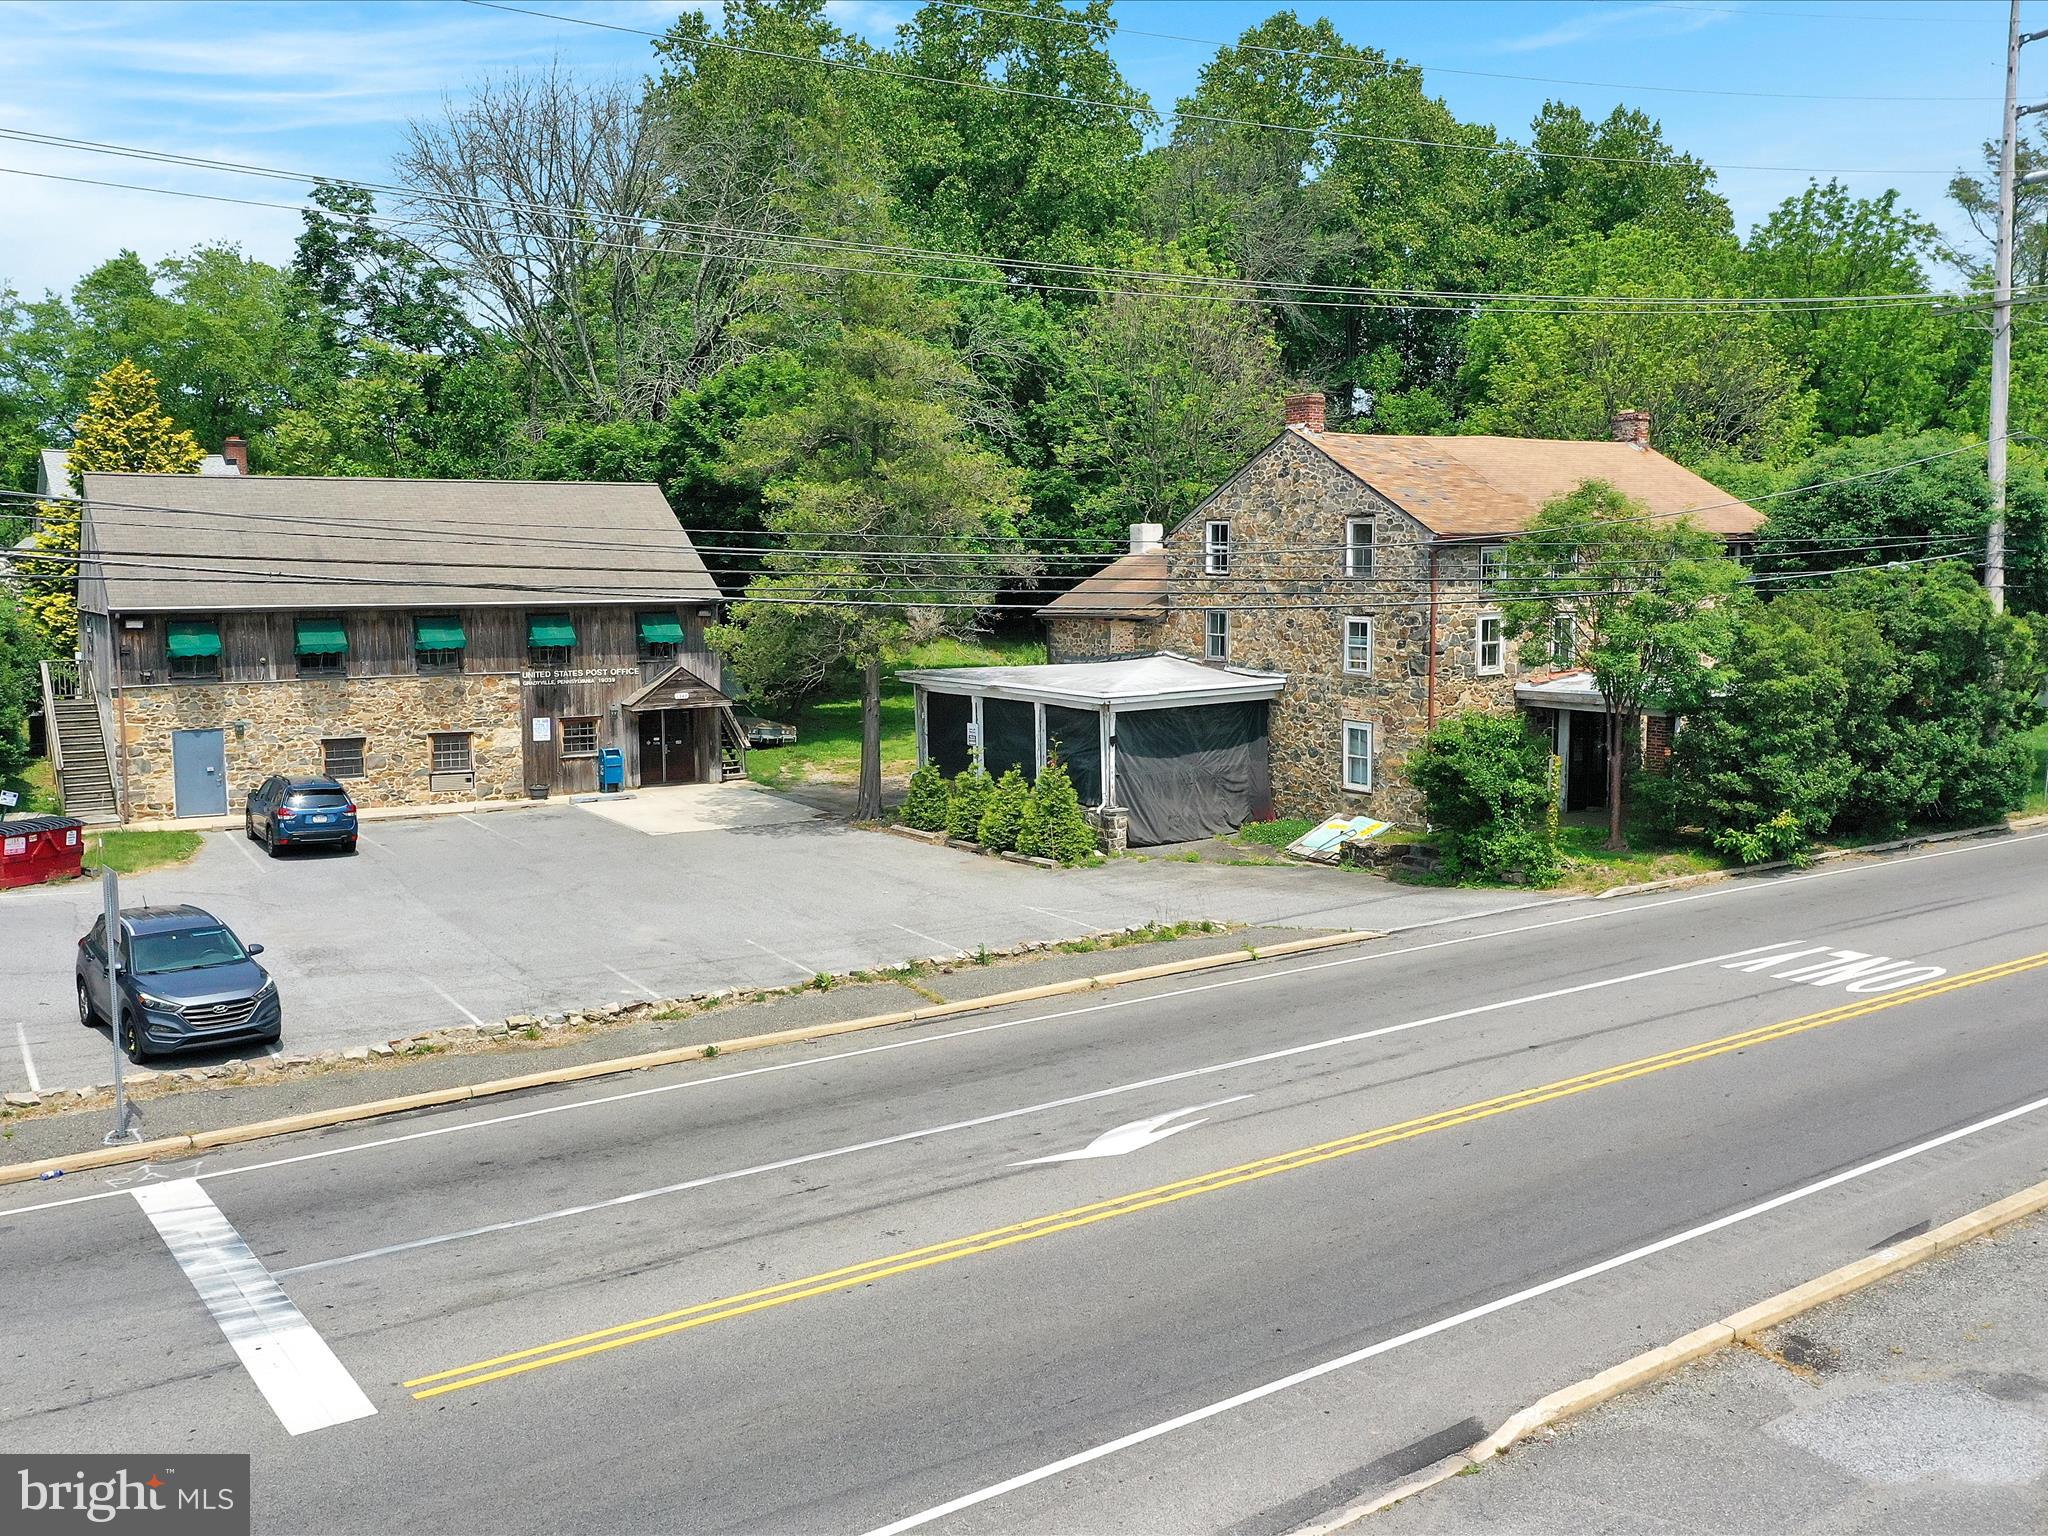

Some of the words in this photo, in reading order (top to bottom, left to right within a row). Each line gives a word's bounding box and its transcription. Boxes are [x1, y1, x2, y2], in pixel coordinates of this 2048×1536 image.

[522, 670, 551, 679] UNITED
[554, 669, 583, 678] STATES
[585, 668, 608, 676] POST
[610, 667, 640, 676] OFFICE
[1719, 945, 1947, 993] ONLY
